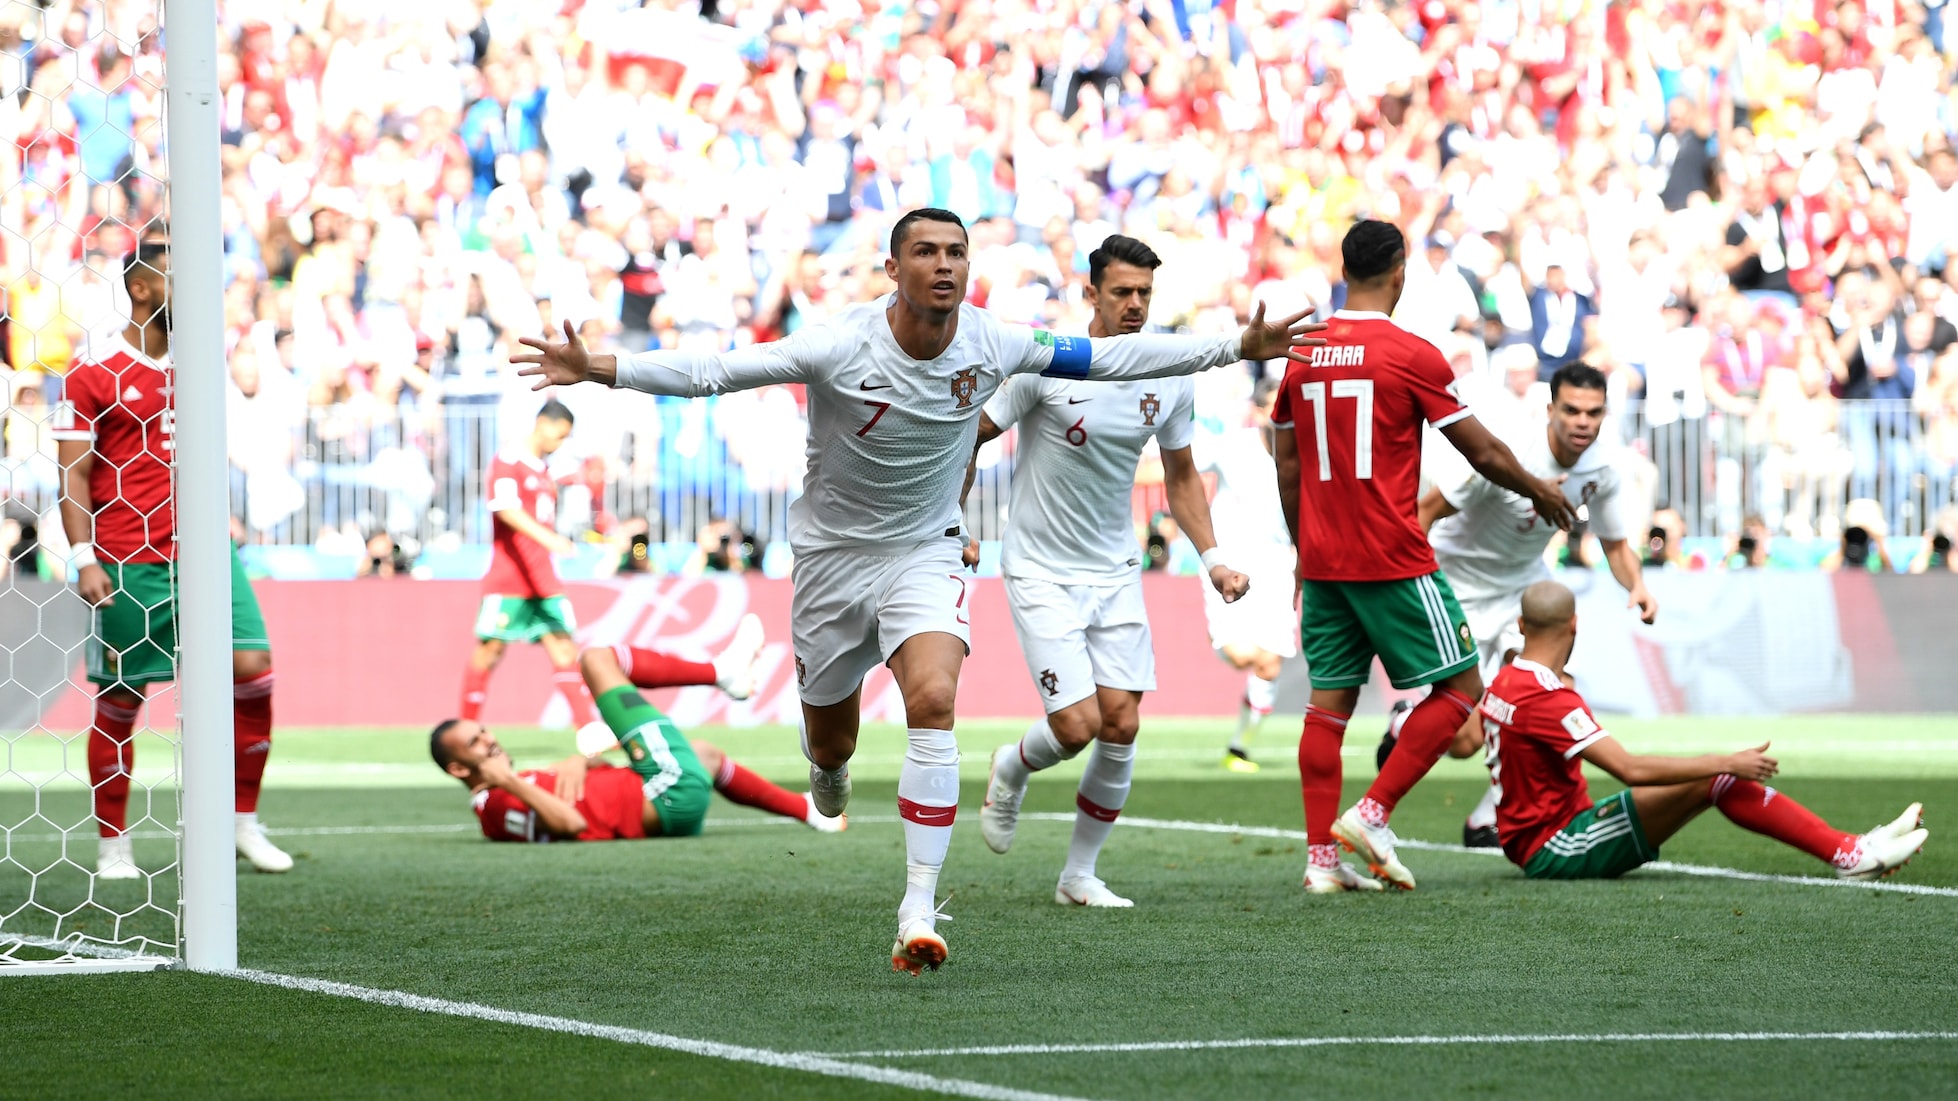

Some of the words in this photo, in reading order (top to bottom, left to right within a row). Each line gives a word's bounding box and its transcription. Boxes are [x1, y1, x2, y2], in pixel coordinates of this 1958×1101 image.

[856, 400, 891, 437] 7
[1066, 415, 1087, 446] 6
[1301, 379, 1374, 481] 17
[949, 574, 965, 609] 7
